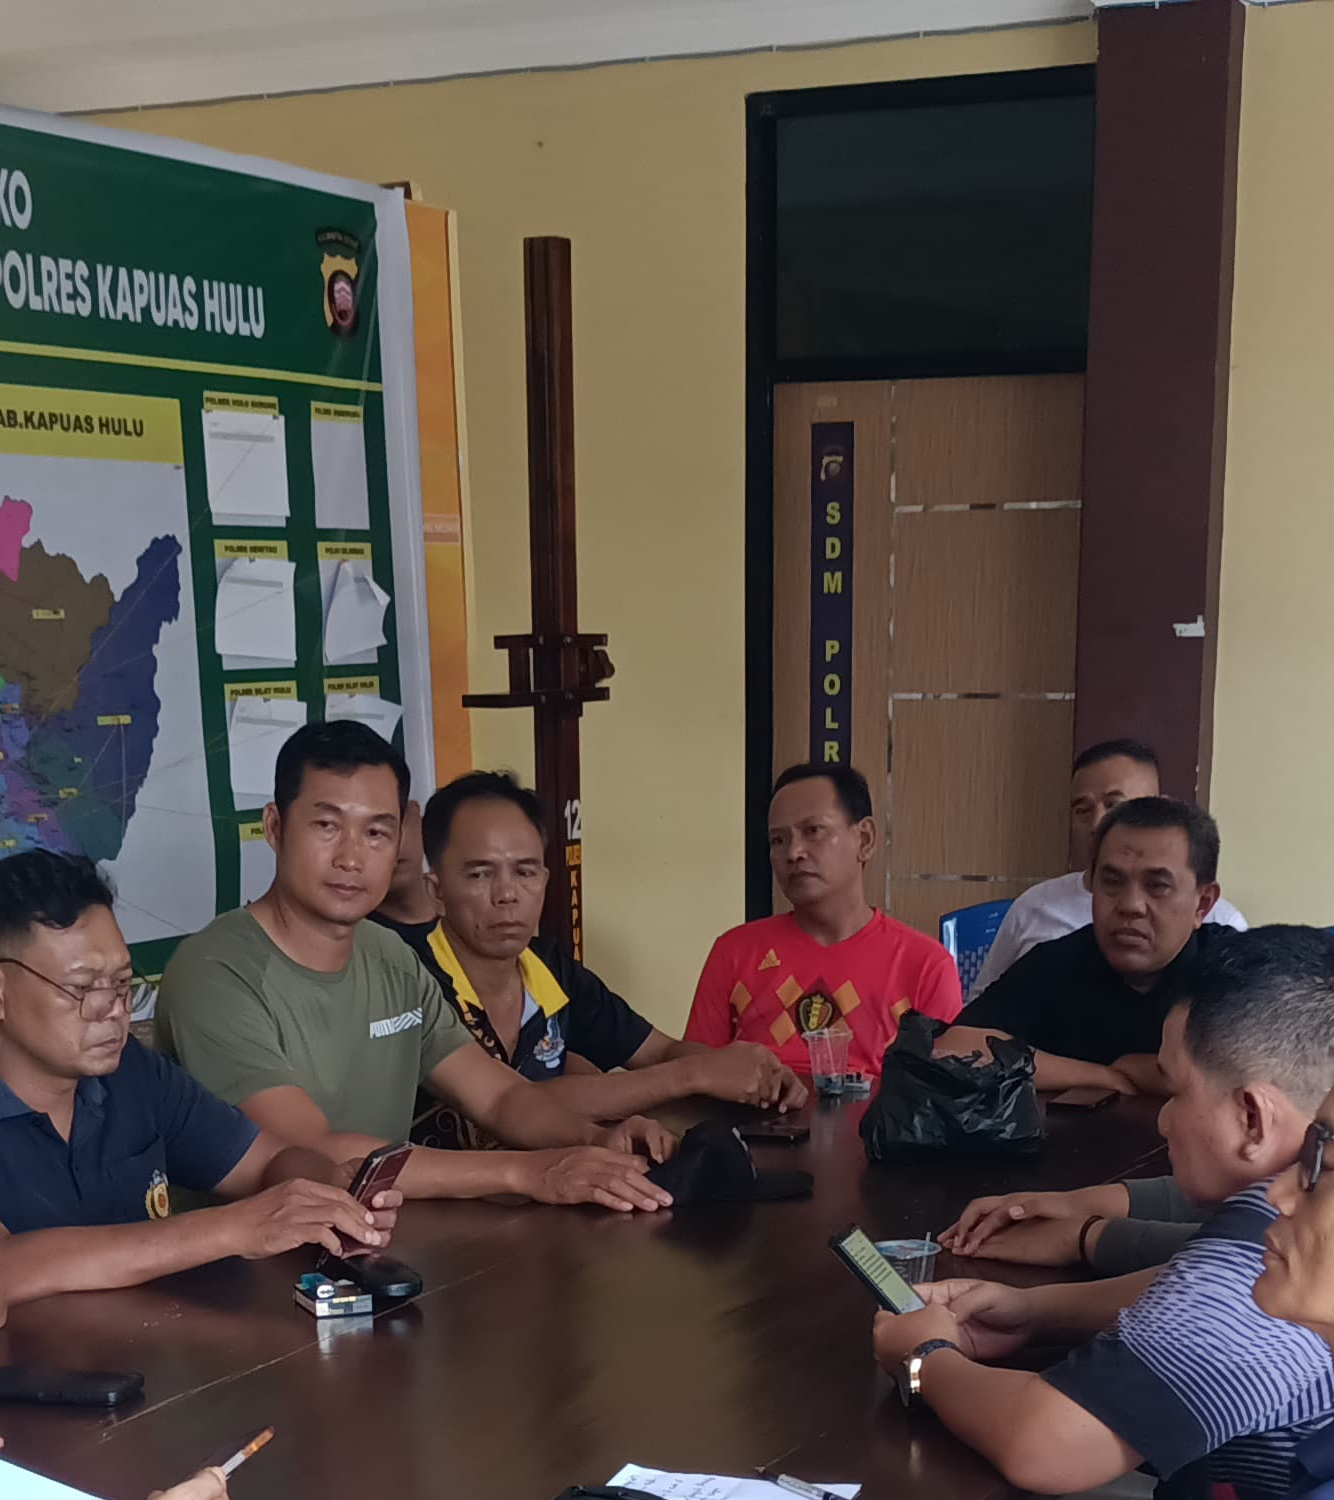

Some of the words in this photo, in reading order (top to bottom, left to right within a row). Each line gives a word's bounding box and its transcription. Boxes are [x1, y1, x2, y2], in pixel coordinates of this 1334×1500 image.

[96, 264, 200, 332] KAPUAS
[204, 279, 266, 339] HULU
[98, 416, 144, 437] HULU
[822, 502, 843, 594] SDM
